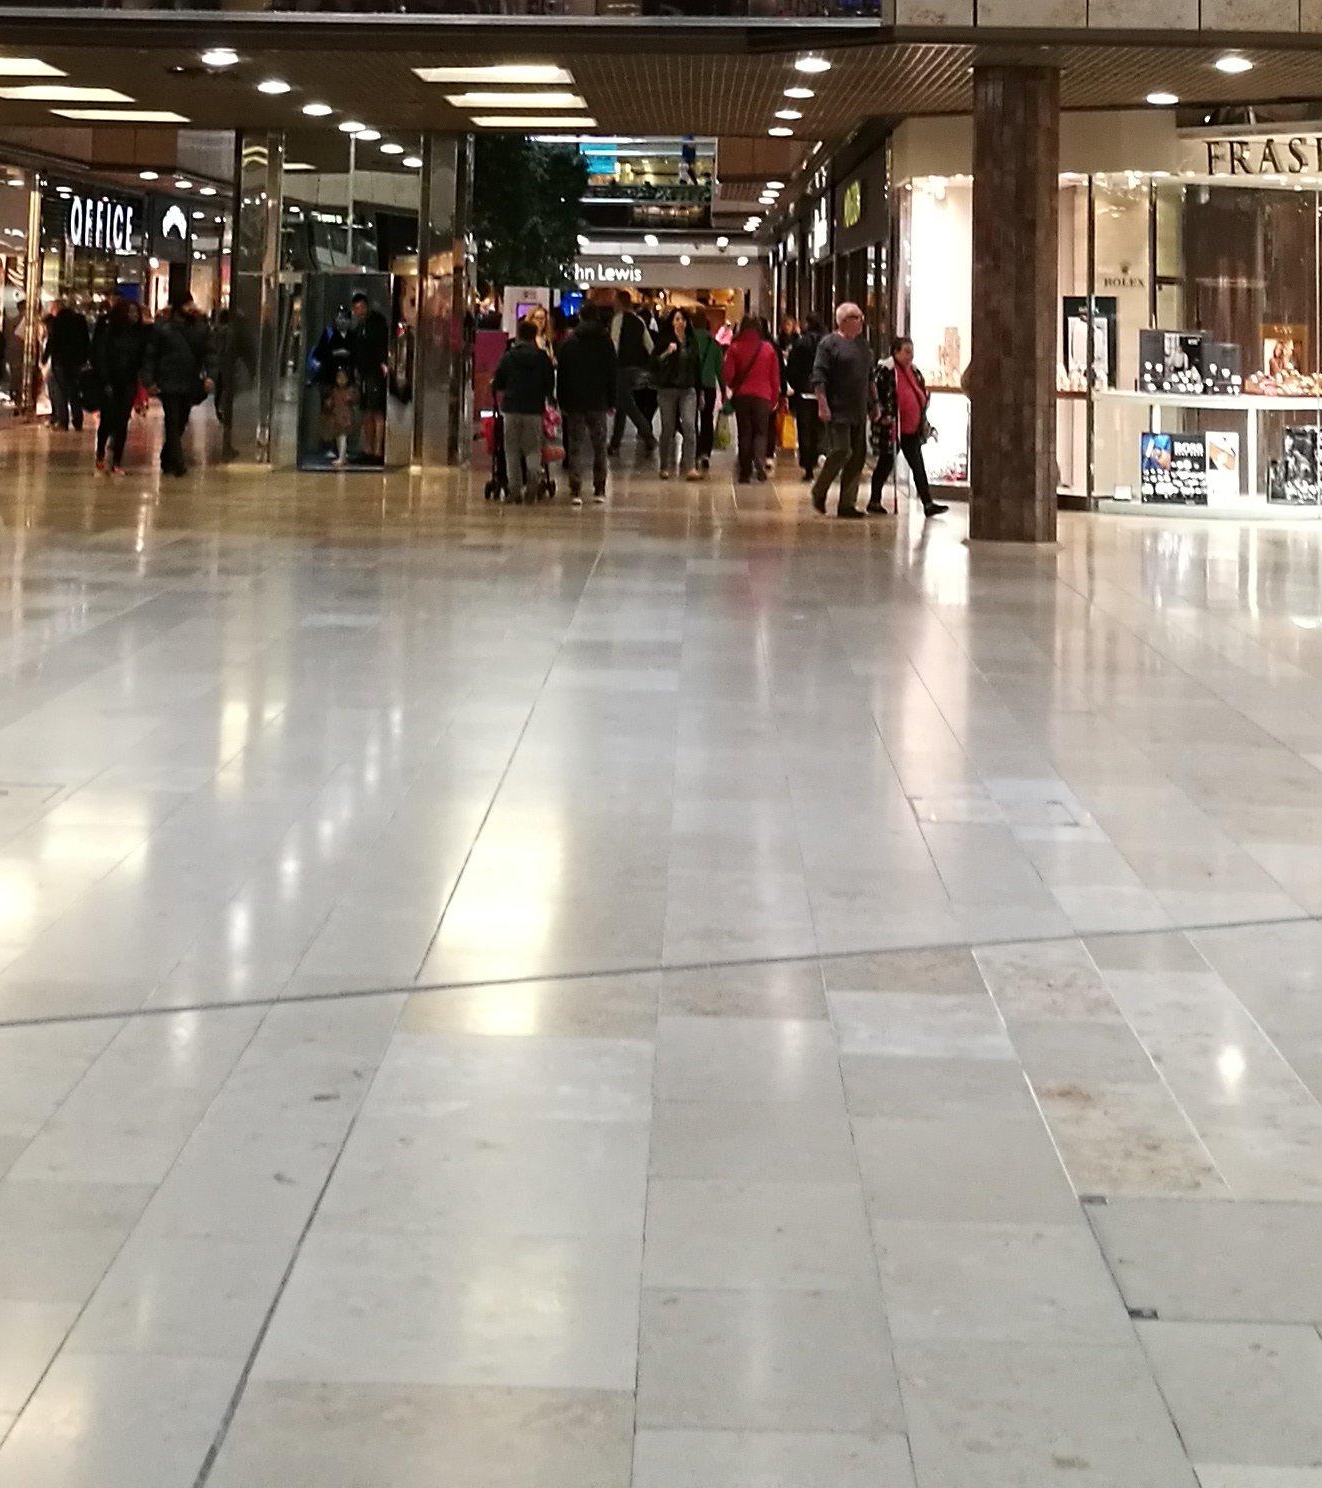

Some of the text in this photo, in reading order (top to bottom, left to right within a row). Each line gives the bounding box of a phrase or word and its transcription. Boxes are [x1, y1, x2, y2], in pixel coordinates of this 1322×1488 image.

[71, 195, 134, 252] OFFICE
[597, 263, 642, 282] Lewis
[1103, 277, 1145, 288] ROLEX
